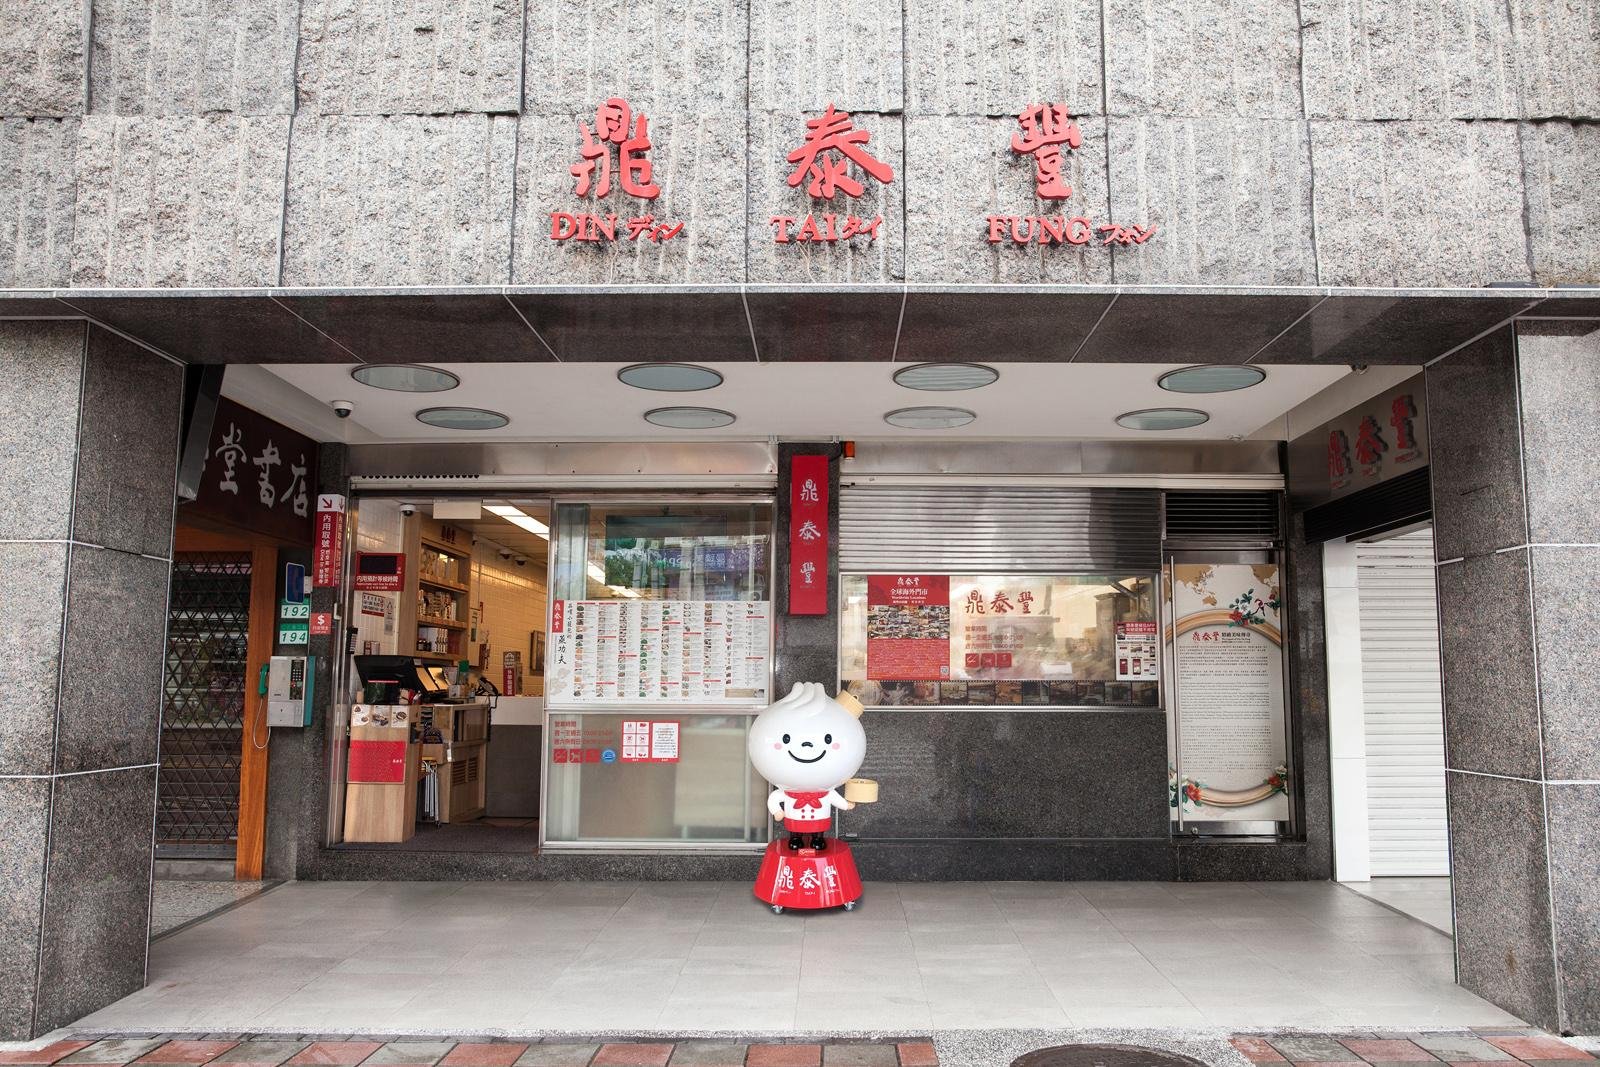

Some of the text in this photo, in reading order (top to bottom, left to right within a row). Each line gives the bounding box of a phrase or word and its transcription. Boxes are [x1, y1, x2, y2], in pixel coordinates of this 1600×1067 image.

[550, 212, 1157, 245] DIN ディン TAI タイ FUNG フォン
[205, 422, 308, 518] 堂書店
[799, 478, 821, 585] 鼎泰豐
[283, 606, 308, 617] 192
[965, 590, 1034, 614] 鼎泰豐
[317, 613, 325, 626] $
[281, 632, 306, 642] 194
[778, 865, 837, 890] 鼎泰豐
